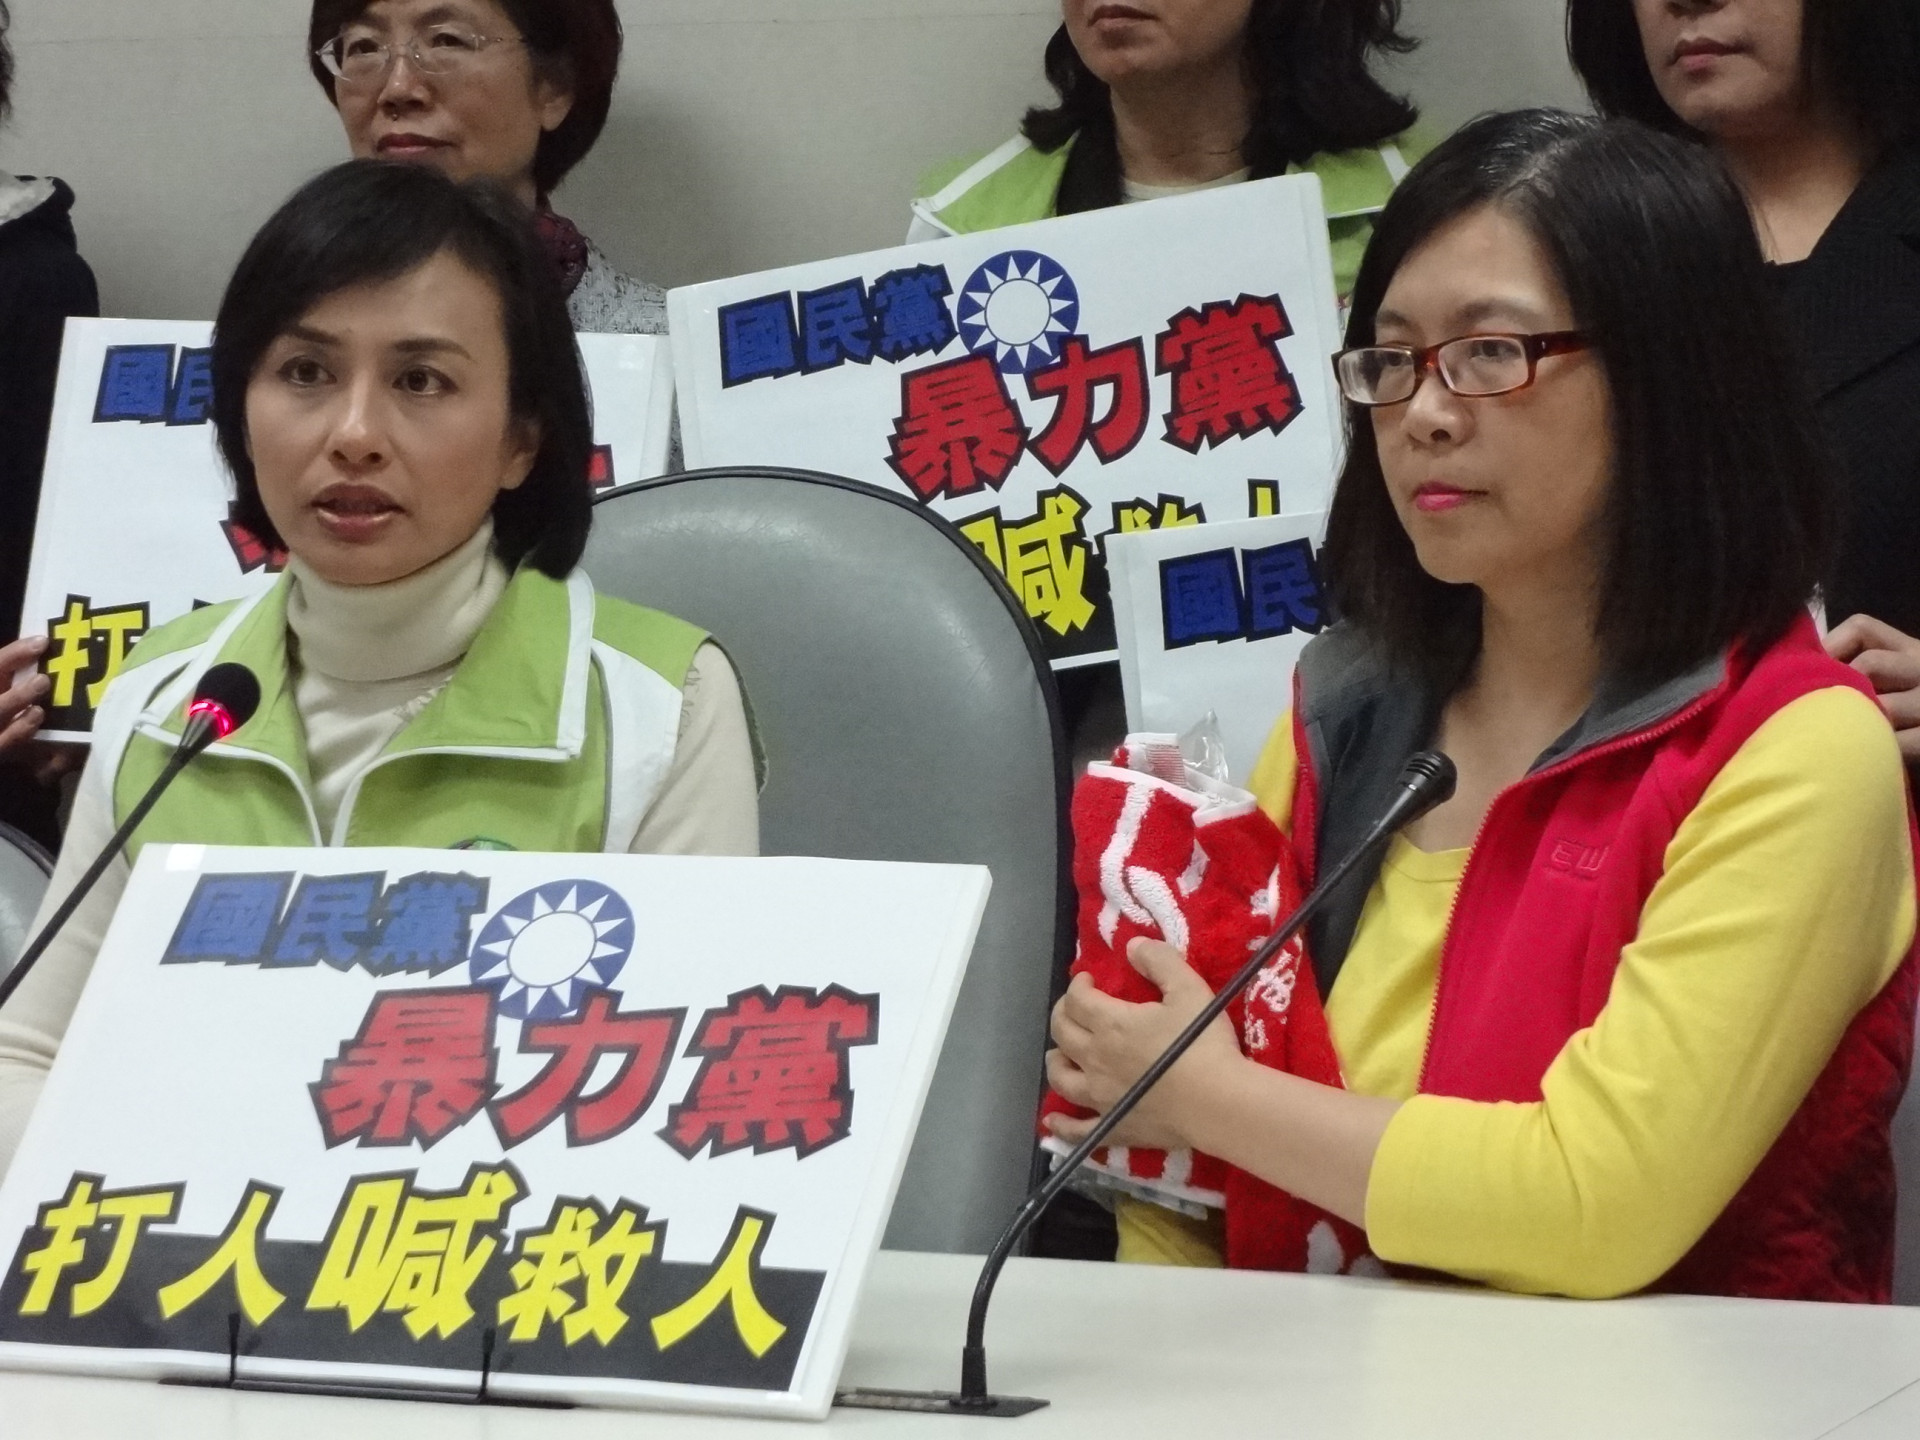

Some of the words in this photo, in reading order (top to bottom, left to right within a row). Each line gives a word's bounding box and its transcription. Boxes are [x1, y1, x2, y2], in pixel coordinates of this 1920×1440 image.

[718, 263, 959, 388] 國民黨
[884, 293, 1305, 501] 暴力黨
[159, 871, 490, 977] 國民黨
[307, 982, 880, 1160] 暴力黨
[18, 1160, 788, 1360] 打人喊救人
